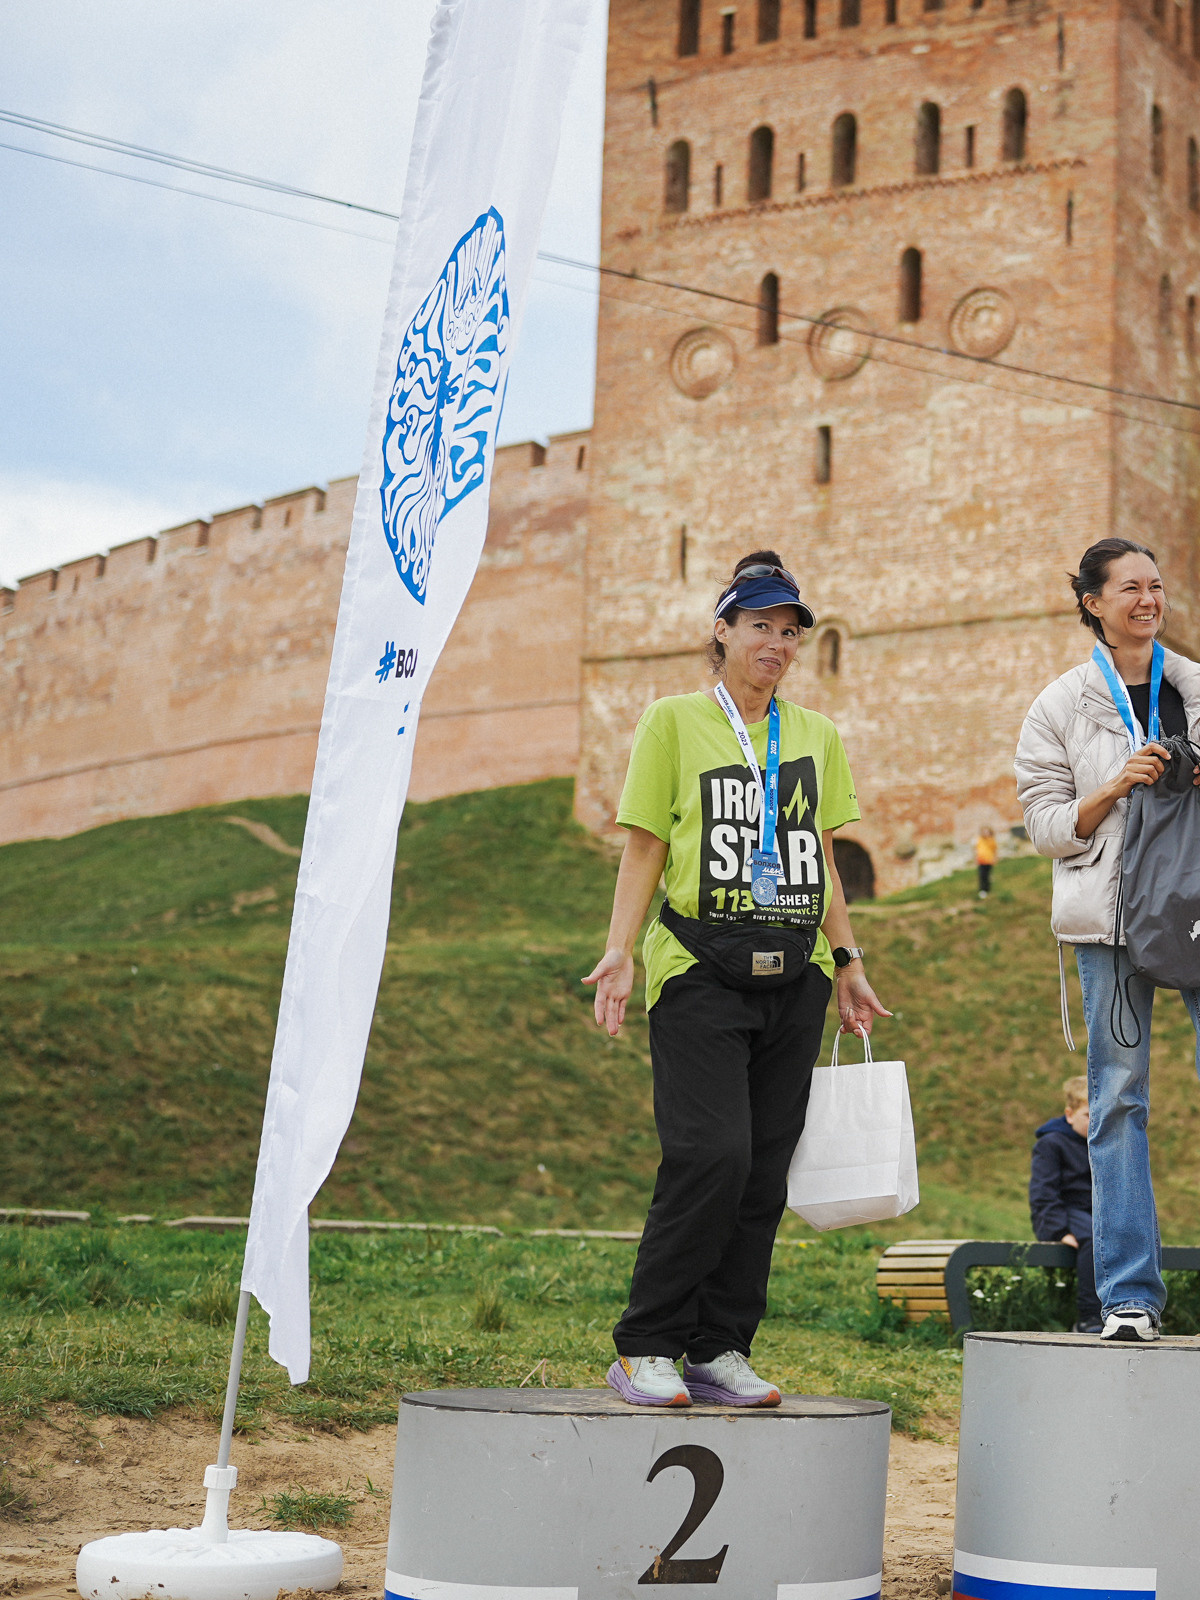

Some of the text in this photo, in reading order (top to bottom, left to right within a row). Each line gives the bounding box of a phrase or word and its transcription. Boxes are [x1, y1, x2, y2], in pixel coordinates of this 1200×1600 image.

[738, 731, 748, 746] 2023
[770, 740, 778, 755] 2023
[711, 778, 776, 824] IRO
[710, 887, 755, 912] 113
[771, 894, 810, 906] ISHER
[811, 893, 820, 916] 2022
[637, 1444, 729, 1584] 2
